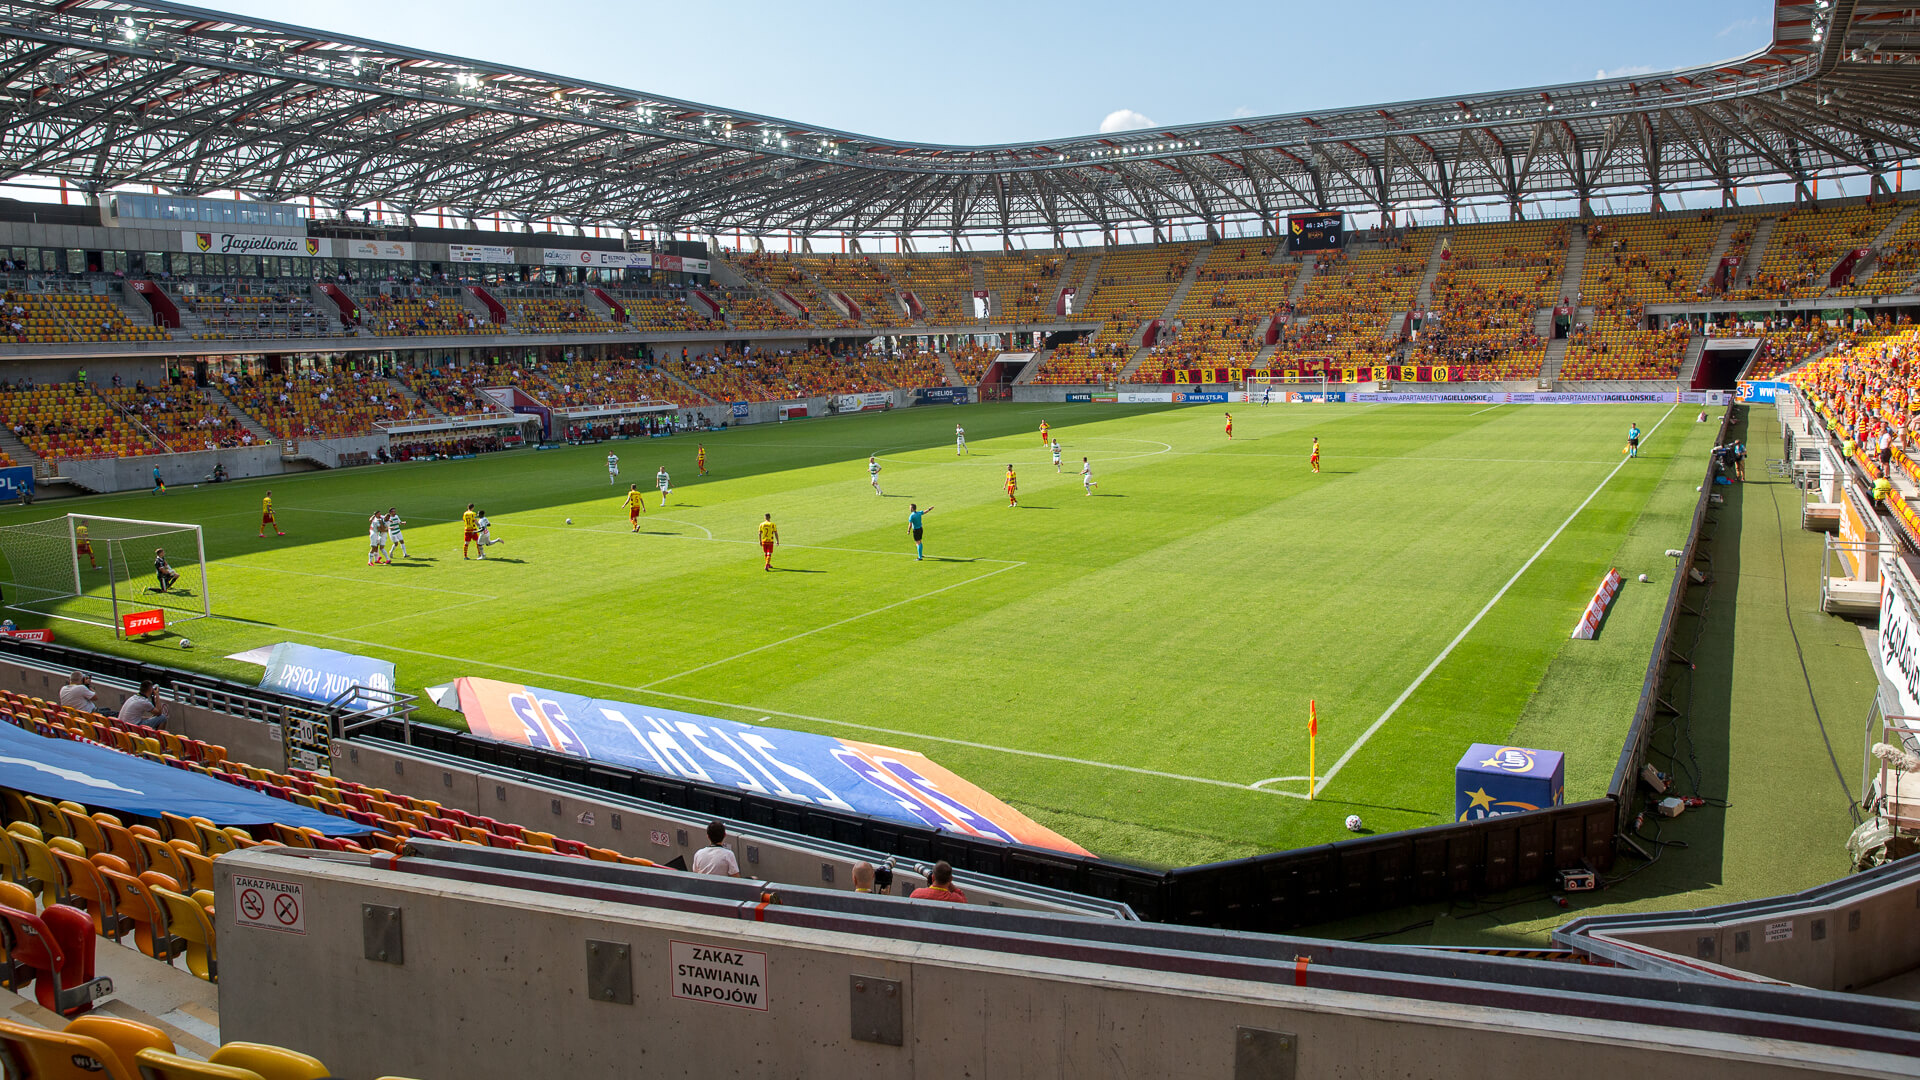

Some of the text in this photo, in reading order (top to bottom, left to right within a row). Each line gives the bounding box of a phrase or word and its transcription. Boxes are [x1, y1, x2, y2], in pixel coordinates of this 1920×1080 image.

[221, 234, 298, 253] Jagiellonia
[1737, 384, 1754, 398] STS
[278, 664, 321, 694] Polski
[302, 726, 313, 740] 10
[236, 877, 300, 894] ZAKAZ PALENIA
[692, 948, 744, 966] ZAKAZ
[678, 964, 760, 987] STAWIANIA
[682, 982, 758, 1005] NAPOJÓW
